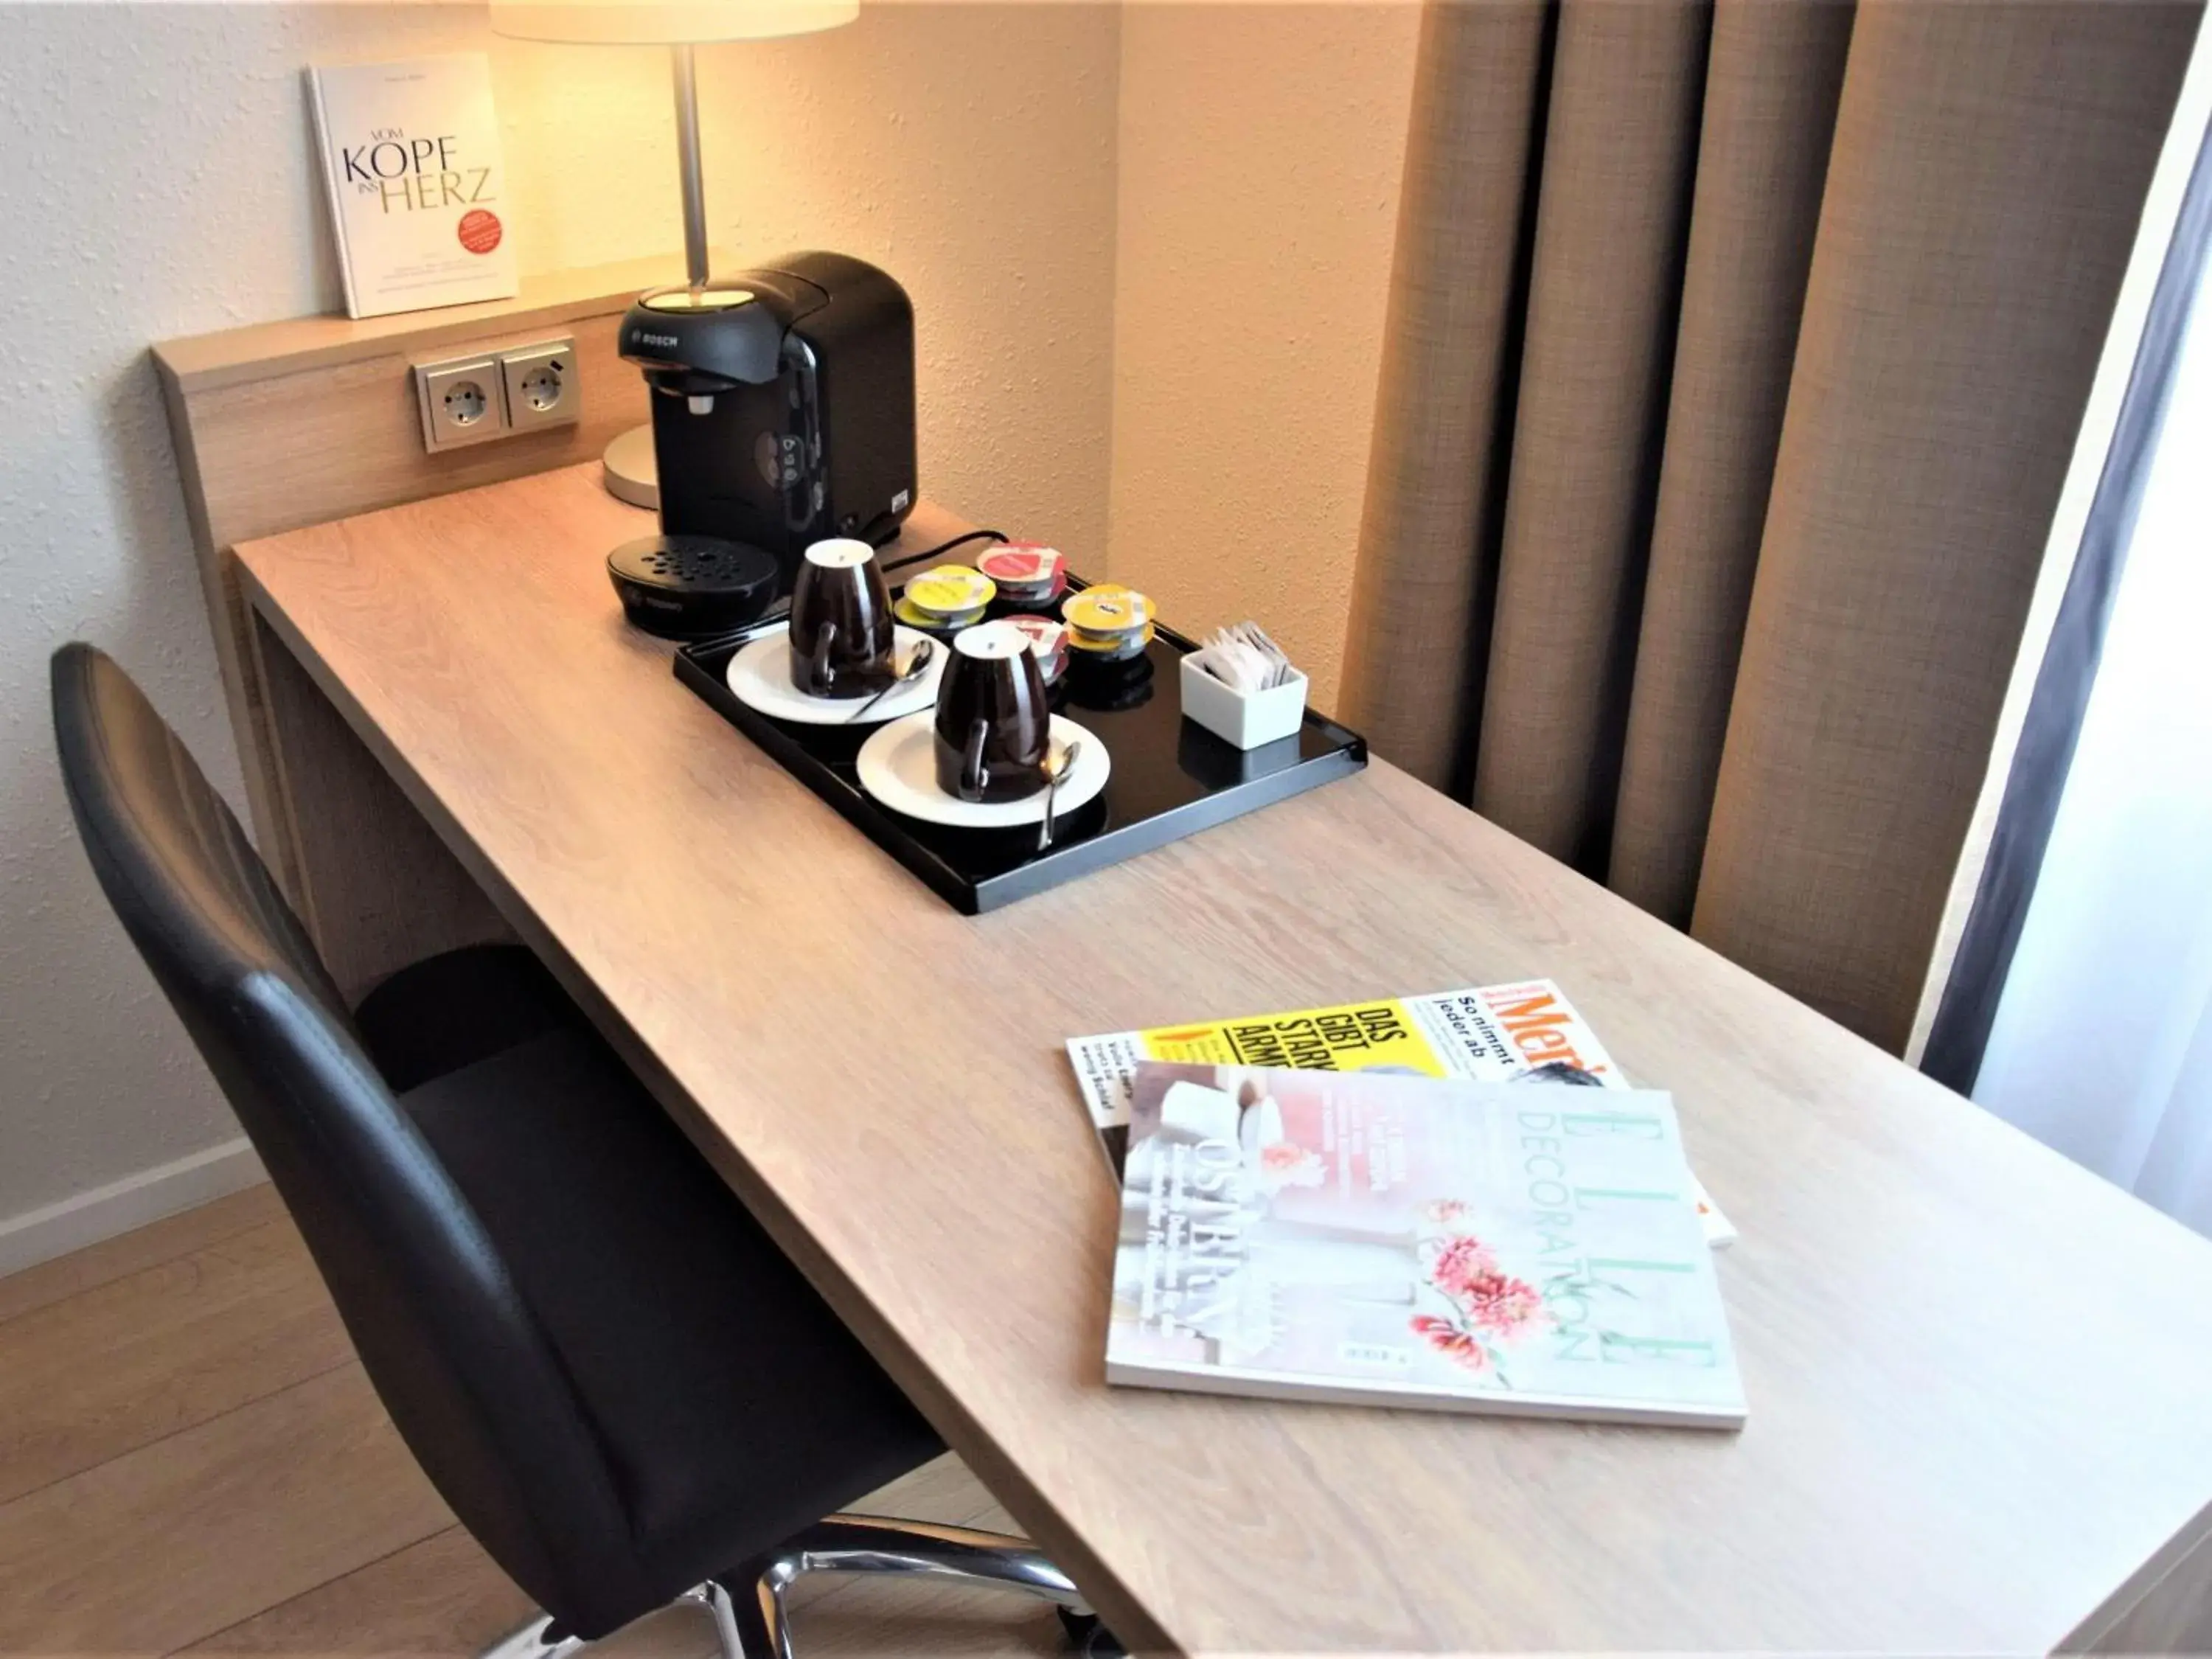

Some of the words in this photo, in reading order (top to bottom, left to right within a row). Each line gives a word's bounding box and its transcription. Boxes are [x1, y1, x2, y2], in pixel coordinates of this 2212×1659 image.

[343, 136, 457, 182] KOPF
[380, 167, 496, 214] HERZ
[1316, 1013, 1371, 1051] GIBT
[1354, 1007, 1408, 1043] DAS
[1432, 998, 1472, 1036] jeder
[1464, 1040, 1487, 1059] ab
[1458, 996, 1478, 1014] So
[1471, 1016, 1515, 1065] nimmt
[1517, 1110, 1598, 1362] DECORATION
[1559, 1111, 1717, 1368] ELLE
